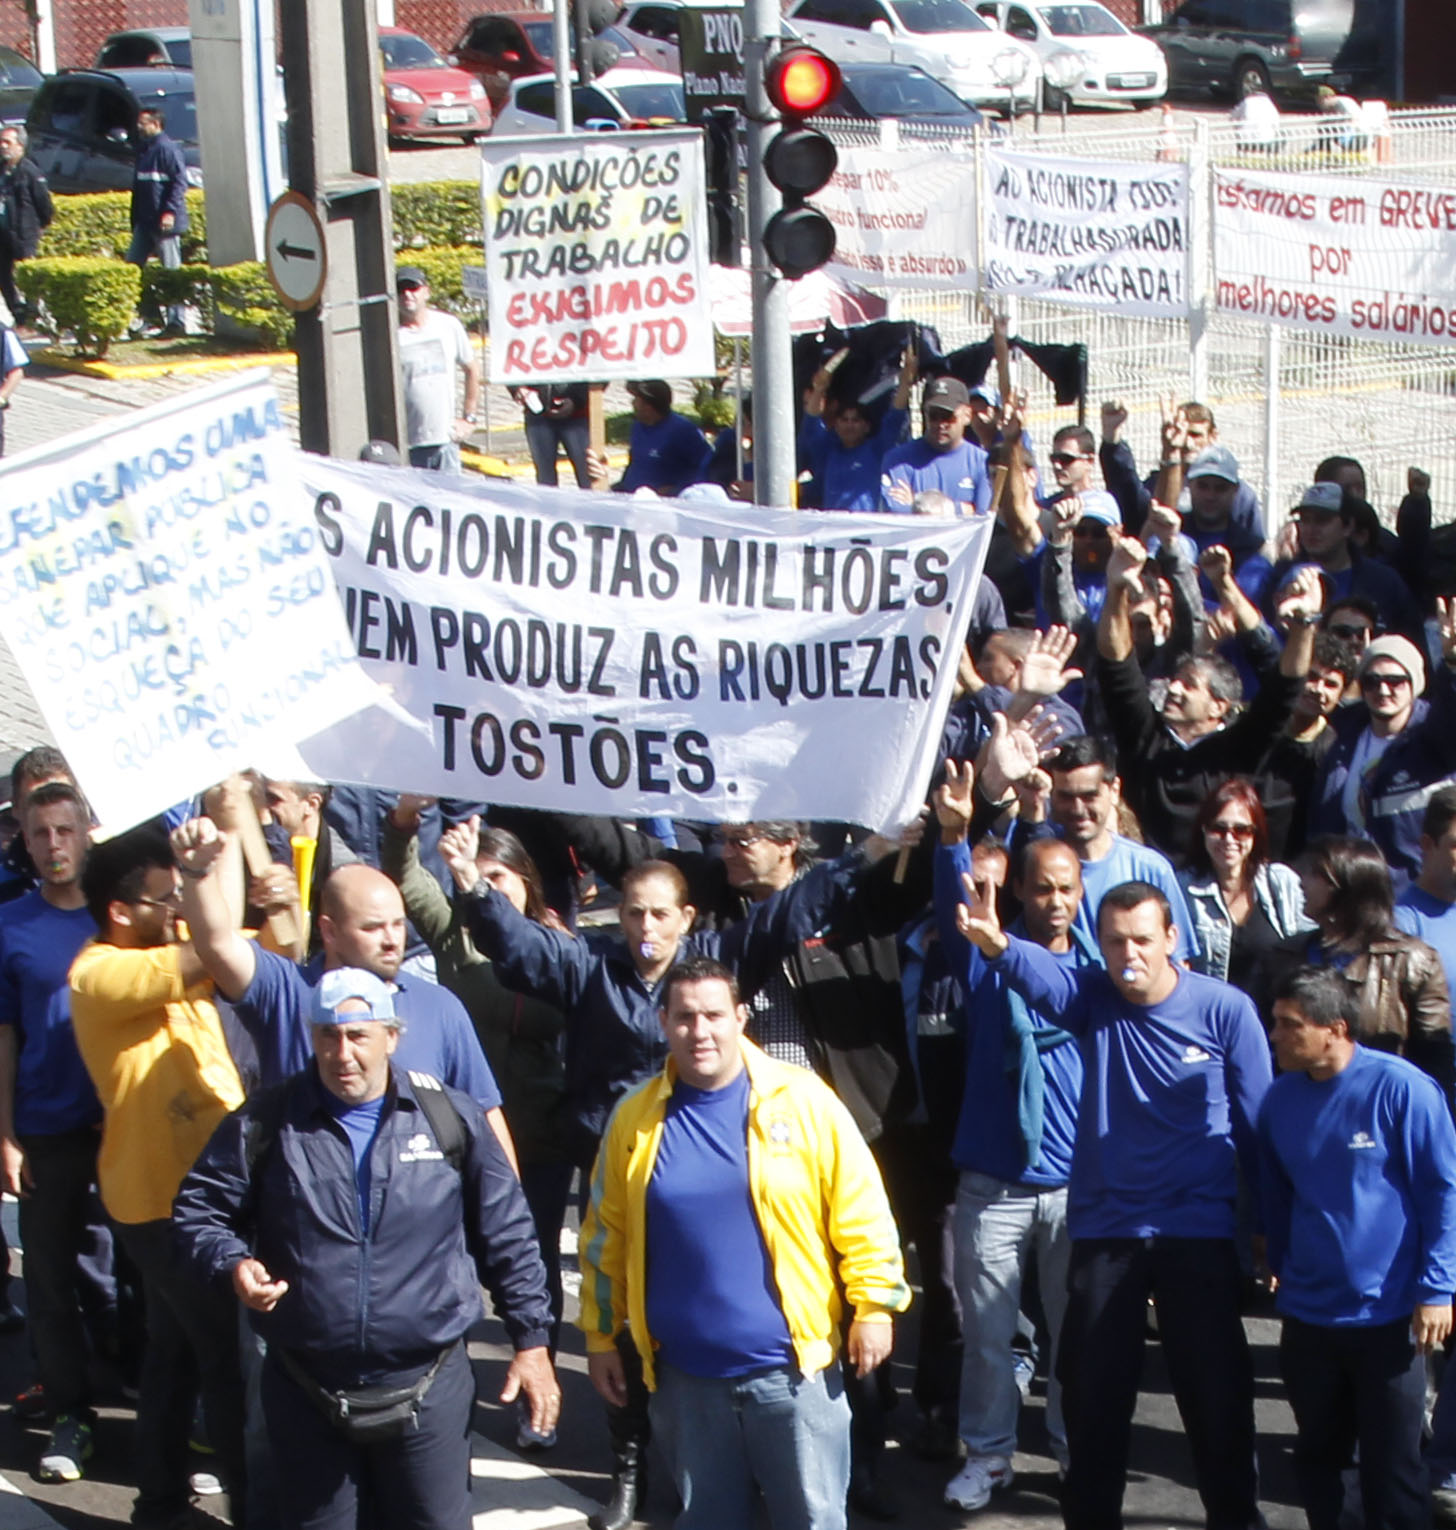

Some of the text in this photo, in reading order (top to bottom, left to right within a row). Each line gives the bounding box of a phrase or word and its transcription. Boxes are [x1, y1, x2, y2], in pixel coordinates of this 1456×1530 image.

[702, 13, 744, 63] PNQ
[685, 71, 719, 95] Plano
[497, 147, 681, 199] CONDIÇÕES
[866, 169, 899, 193] 10%
[1027, 168, 1117, 213] ACIONISTA
[493, 194, 682, 240] DIGNAS DE
[857, 206, 929, 231] funcional
[1329, 196, 1366, 225] em
[500, 232, 690, 281] TRABALHO
[1308, 243, 1352, 283] por
[506, 273, 696, 328] EXIGIMOS
[1217, 275, 1337, 323] melhores
[503, 316, 688, 375] RESPEITO
[224, 500, 271, 541] NO
[314, 491, 952, 616] S ACIONISTAS MILHÕES.
[187, 562, 251, 608] MAS
[430, 606, 616, 697] PRODUZ
[639, 631, 700, 701] AS
[718, 634, 942, 707] RIQUEZAS
[433, 703, 738, 795] TOSTÕES.
